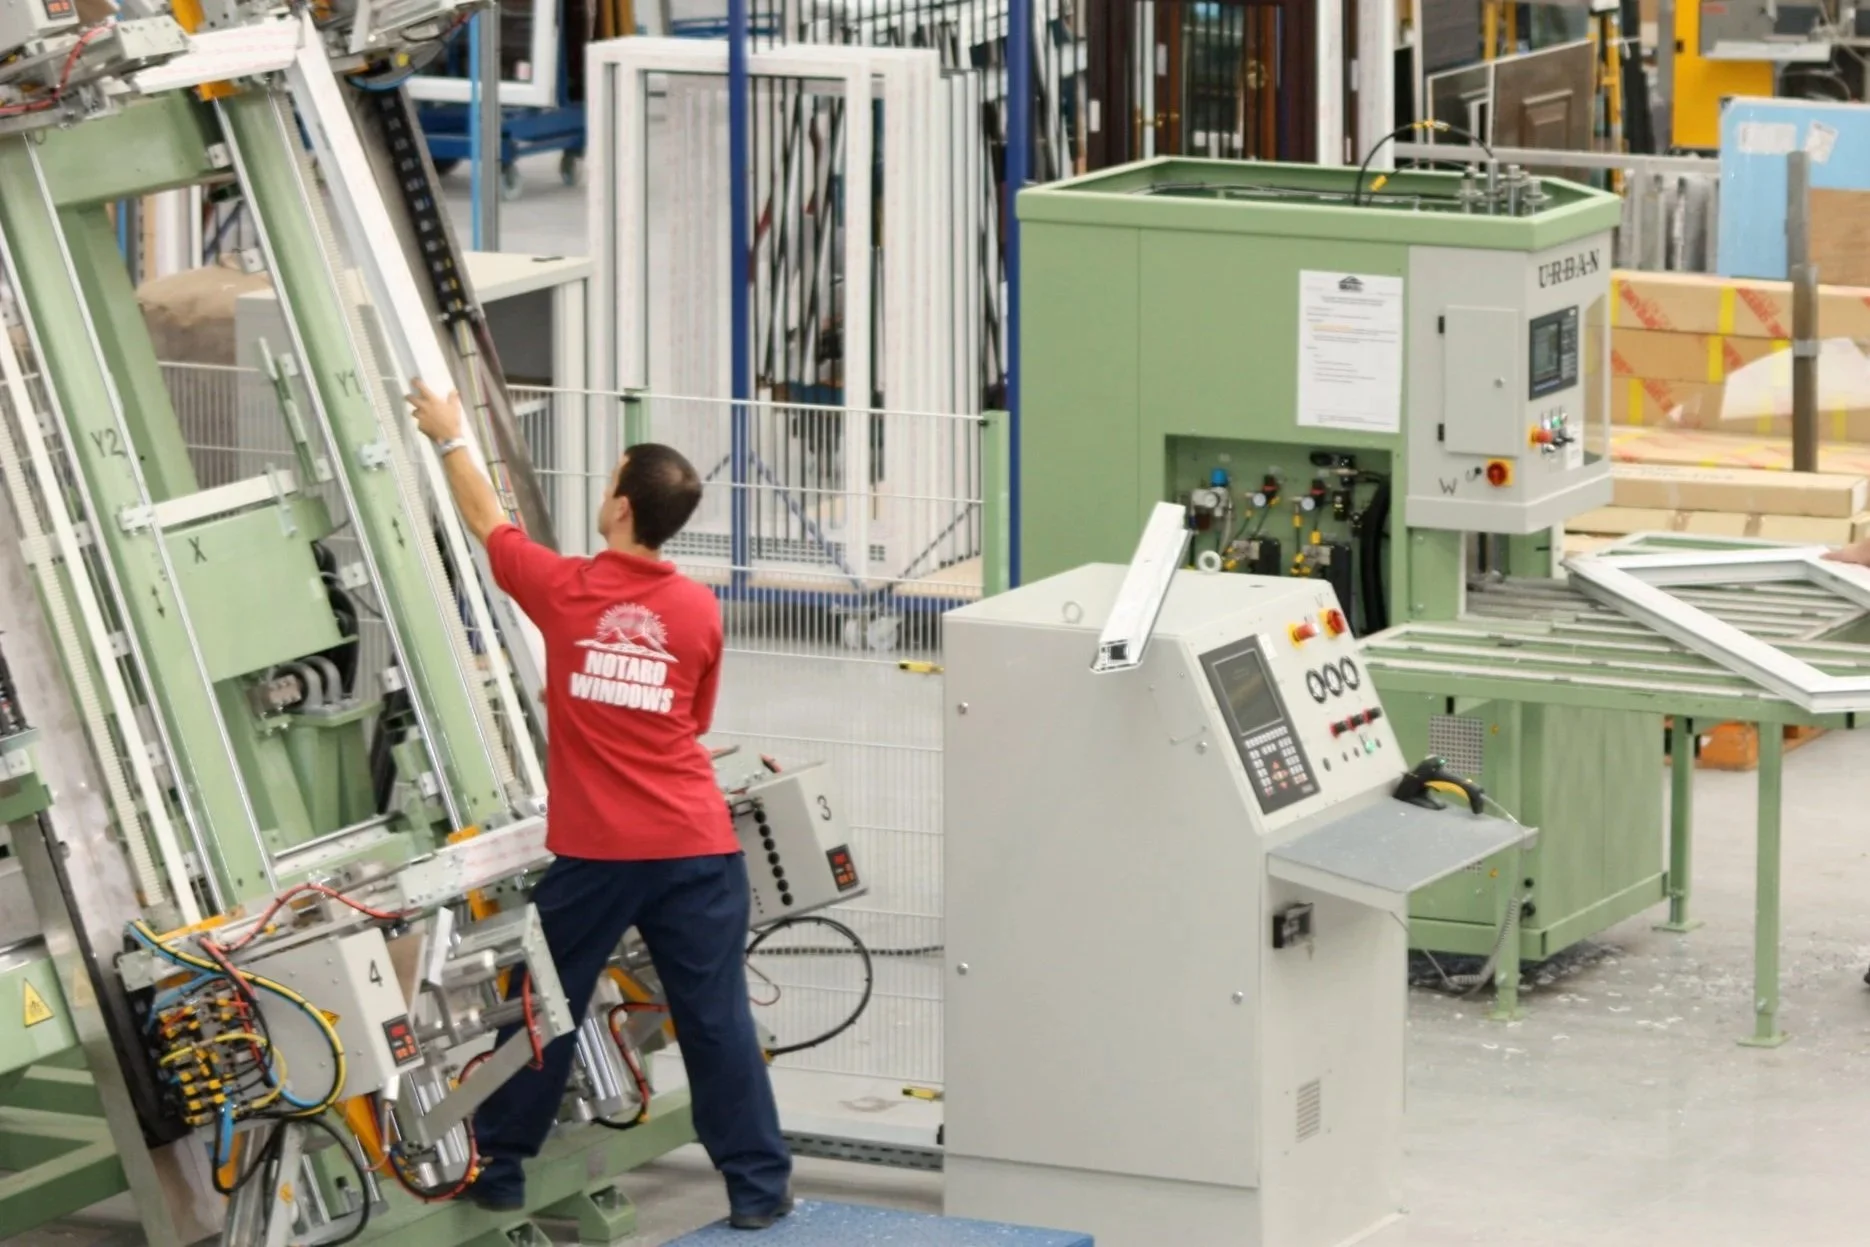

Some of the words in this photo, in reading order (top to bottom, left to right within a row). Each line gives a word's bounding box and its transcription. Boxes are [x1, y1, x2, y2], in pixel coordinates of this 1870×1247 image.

[90, 428, 127, 458] Y2
[1438, 477, 1457, 497] W
[188, 536, 207, 563] X
[585, 649, 667, 686] NOTARO
[570, 671, 675, 714] WINDOWS
[817, 794, 832, 821] 3
[369, 959, 382, 987] 4
